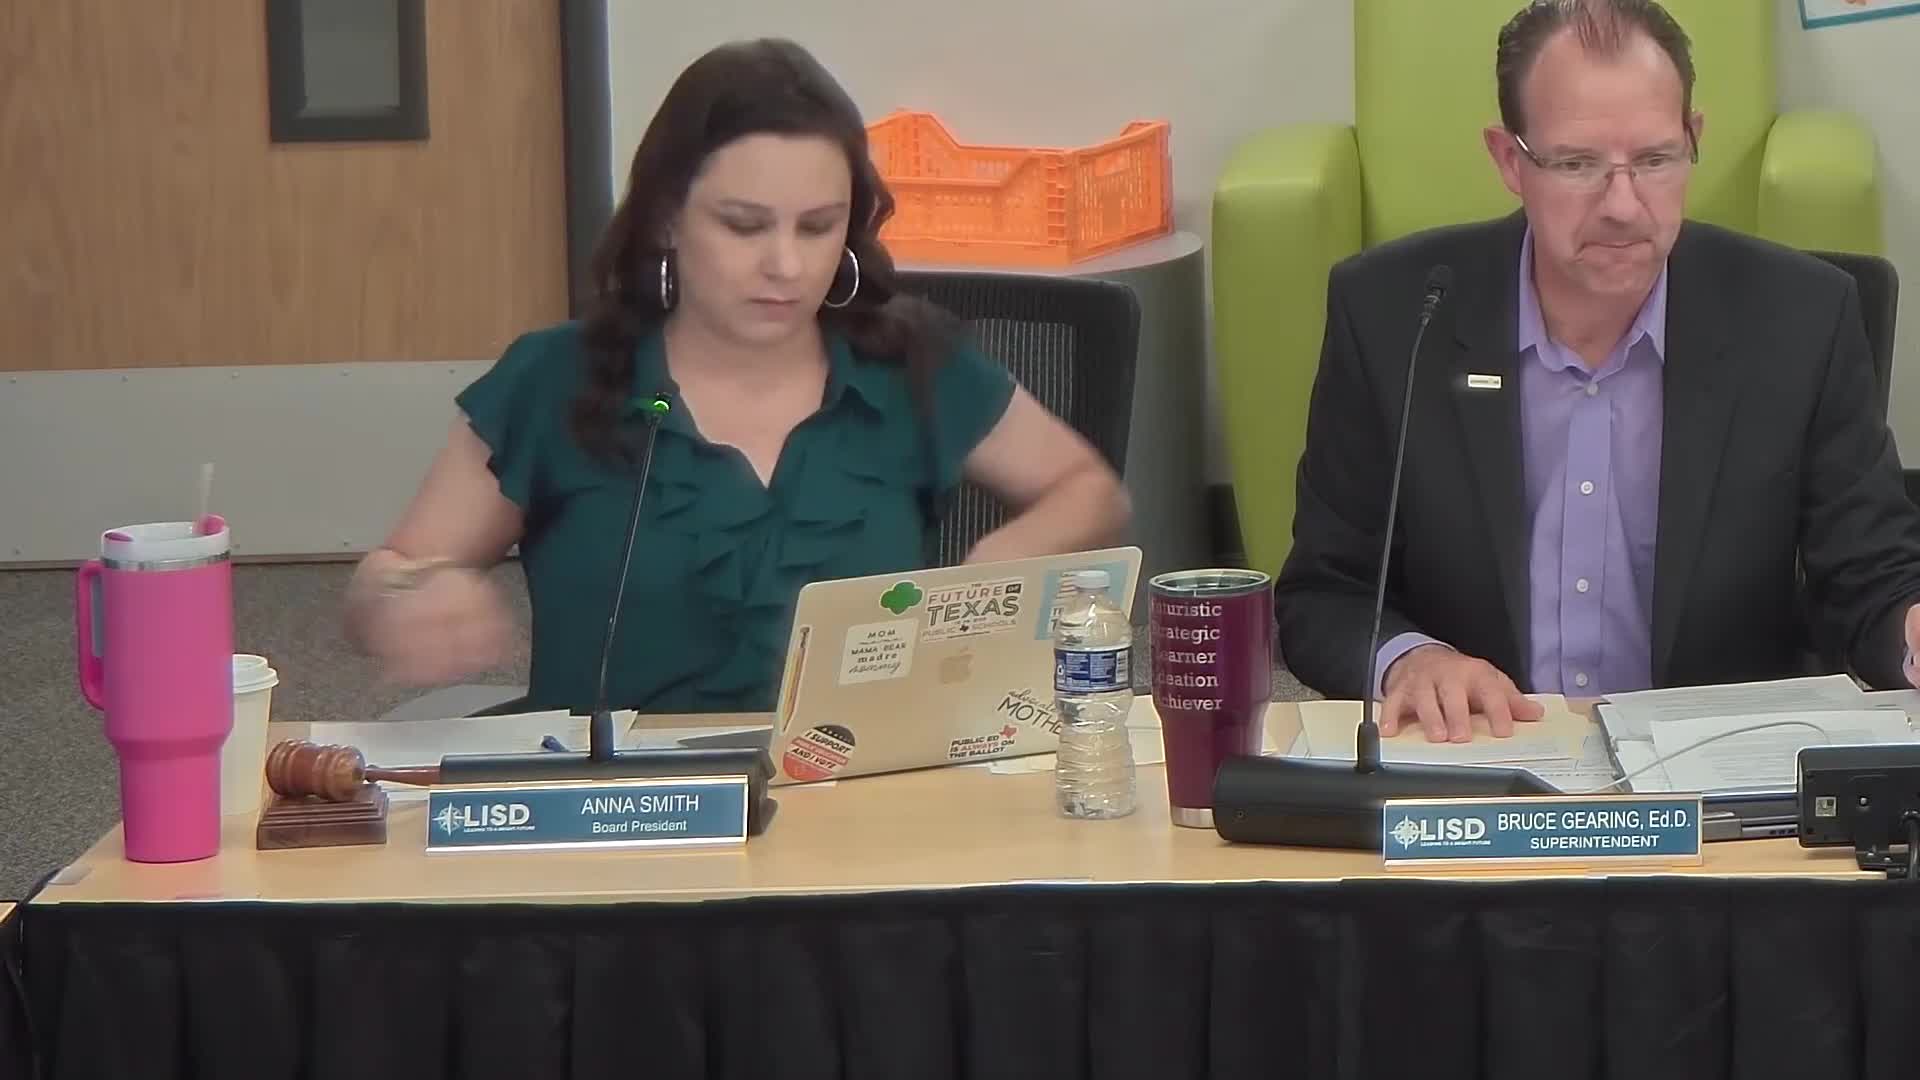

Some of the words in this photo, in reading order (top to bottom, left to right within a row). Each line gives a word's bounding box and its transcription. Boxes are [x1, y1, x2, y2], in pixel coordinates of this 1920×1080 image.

[927, 586, 1003, 604] FUTURE
[927, 595, 1020, 626] TEXAS
[867, 629, 896, 639] MOM
[851, 647, 878, 655] MAMA
[997, 696, 1063, 735] MOTHE
[810, 733, 852, 754] SUPPORT
[951, 736, 985, 745] PUBLIC
[791, 747, 811, 758] AND
[815, 758, 837, 769] VOTE
[969, 747, 1005, 757] BALLOT
[464, 803, 530, 827] LISD
[581, 797, 635, 815] ANNA
[639, 794, 699, 814] SMITH
[592, 820, 628, 834] Board
[631, 819, 688, 833] President
[1420, 818, 1486, 841] LISD
[1497, 812, 1557, 831] BRUCE
[1561, 810, 1644, 830] GEARING,
[1649, 809, 1691, 828] Ed.D.
[1530, 835, 1660, 850] SUPERINTENDENT
